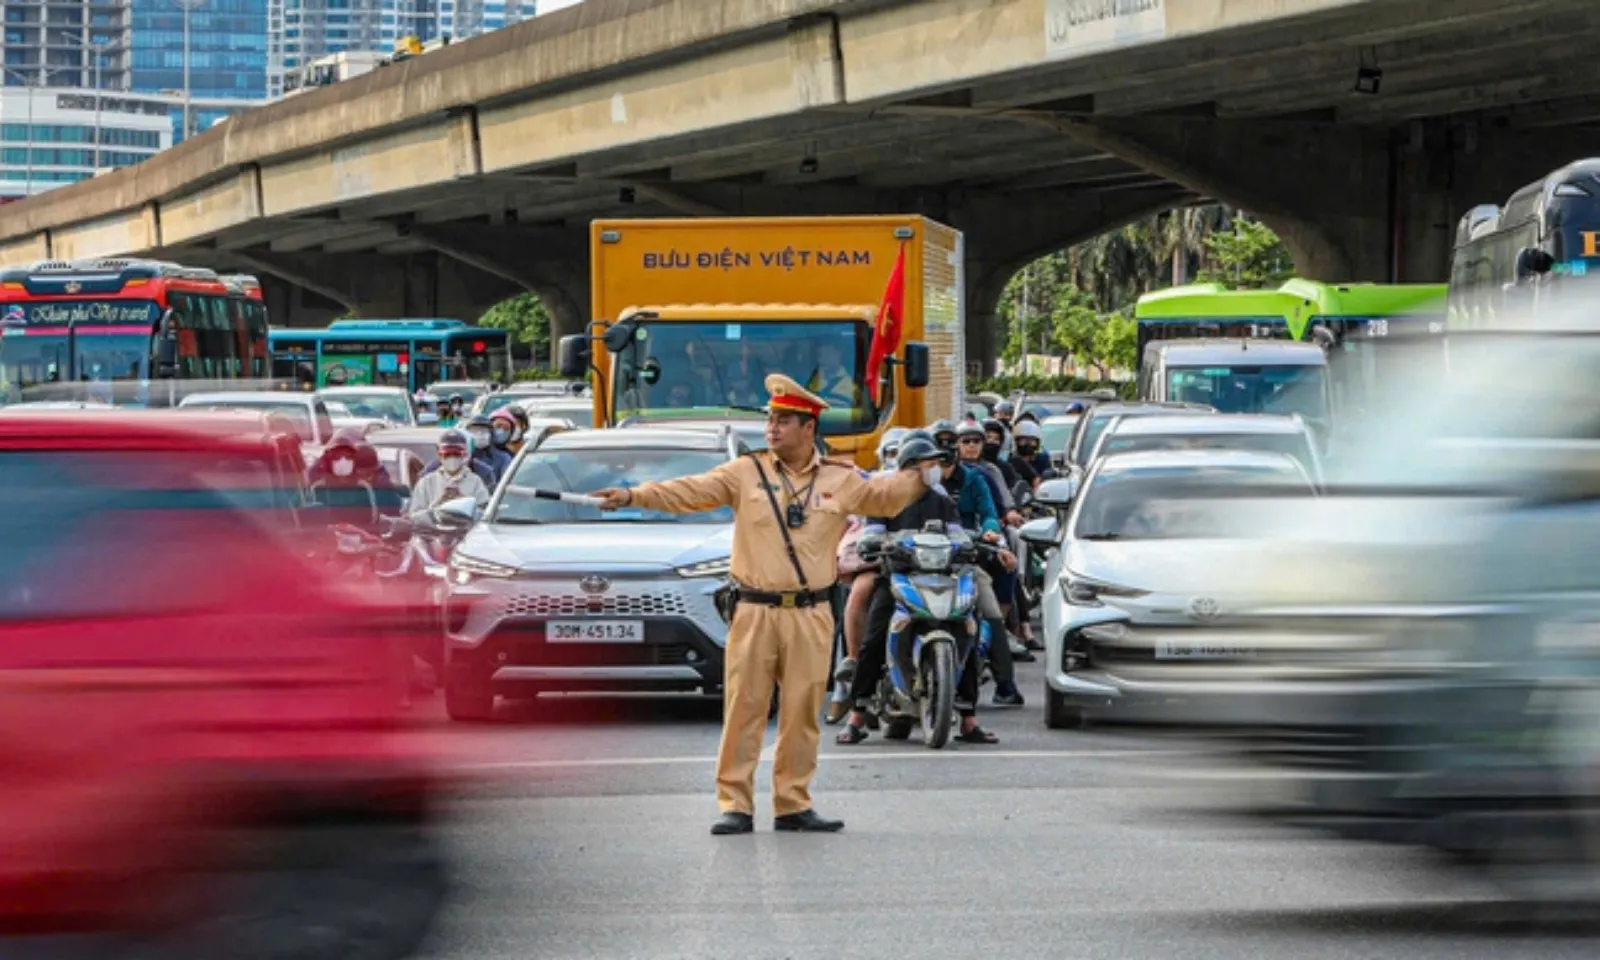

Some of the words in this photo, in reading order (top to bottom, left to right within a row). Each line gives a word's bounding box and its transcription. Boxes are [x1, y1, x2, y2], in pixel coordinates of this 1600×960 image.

[643, 249, 690, 269] BƯU
[696, 247, 750, 271] ĐIỆN
[759, 246, 811, 271] VIỆT
[816, 250, 870, 265] NAM
